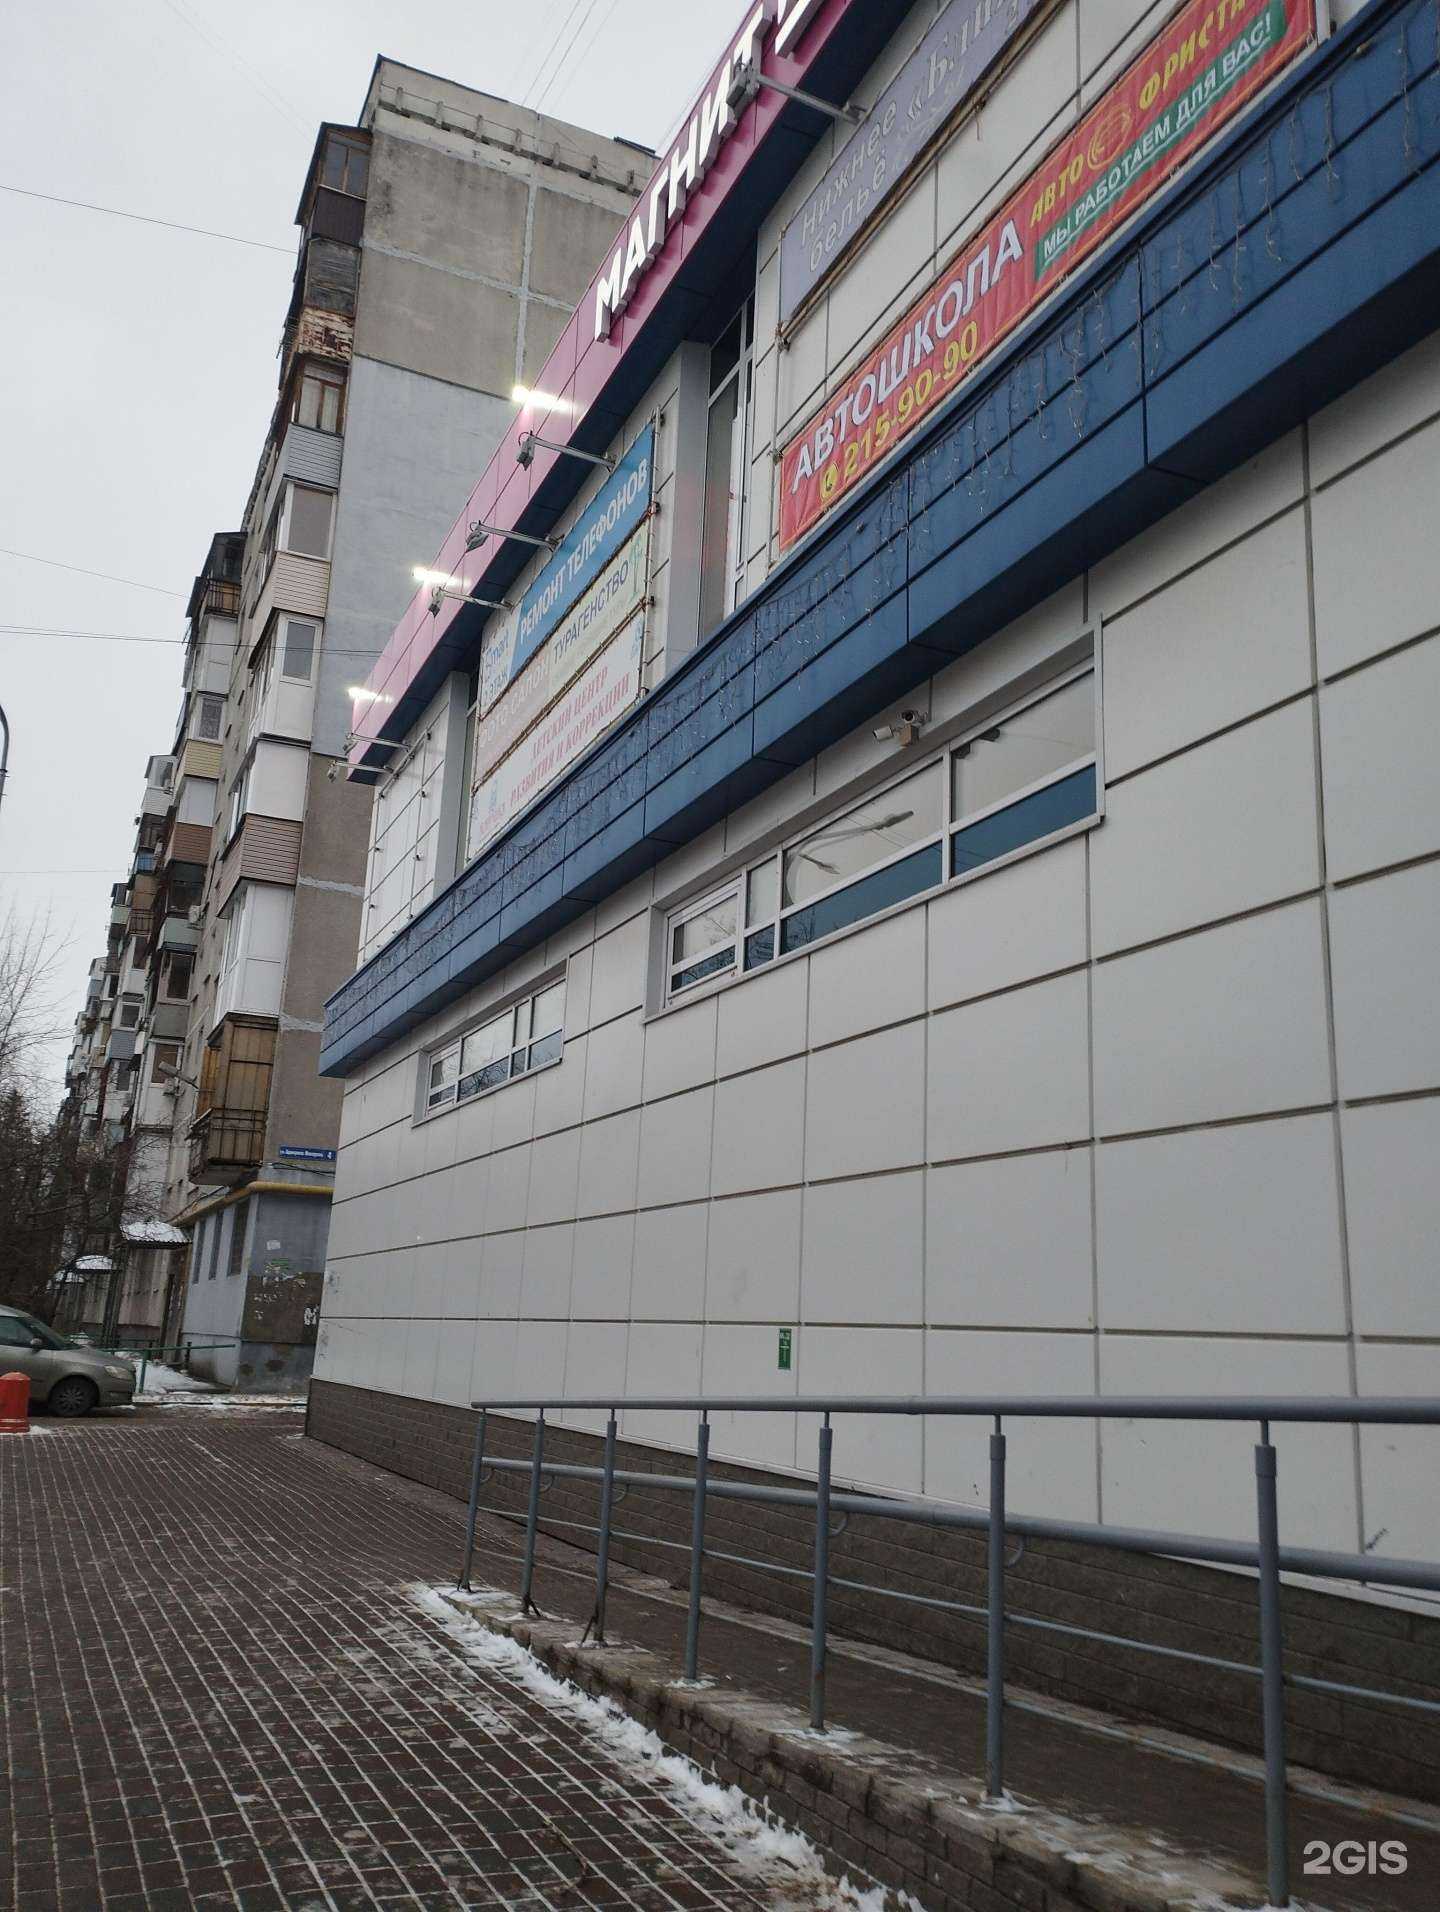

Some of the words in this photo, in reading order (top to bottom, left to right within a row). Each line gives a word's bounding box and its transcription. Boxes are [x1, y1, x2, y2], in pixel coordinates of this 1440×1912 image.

[802, 101, 897, 245] Нижнее
[1030, 153, 1085, 228] АВТО
[1043, 217, 1071, 259] МЫ
[1074, 117, 1170, 225] РАБОТАЕМ
[1176, 69, 1216, 130] ДЛЯ
[1222, 12, 1271, 77] ВАС!
[790, 219, 1023, 494] АВТОШКОЛА
[843, 320, 978, 481] 215-90-90
[520, 562, 569, 645] РЕМОНТ
[567, 458, 648, 582] ТЕЛЕФОНОВ
[553, 560, 629, 665] ТУРАГЕНСТВО
